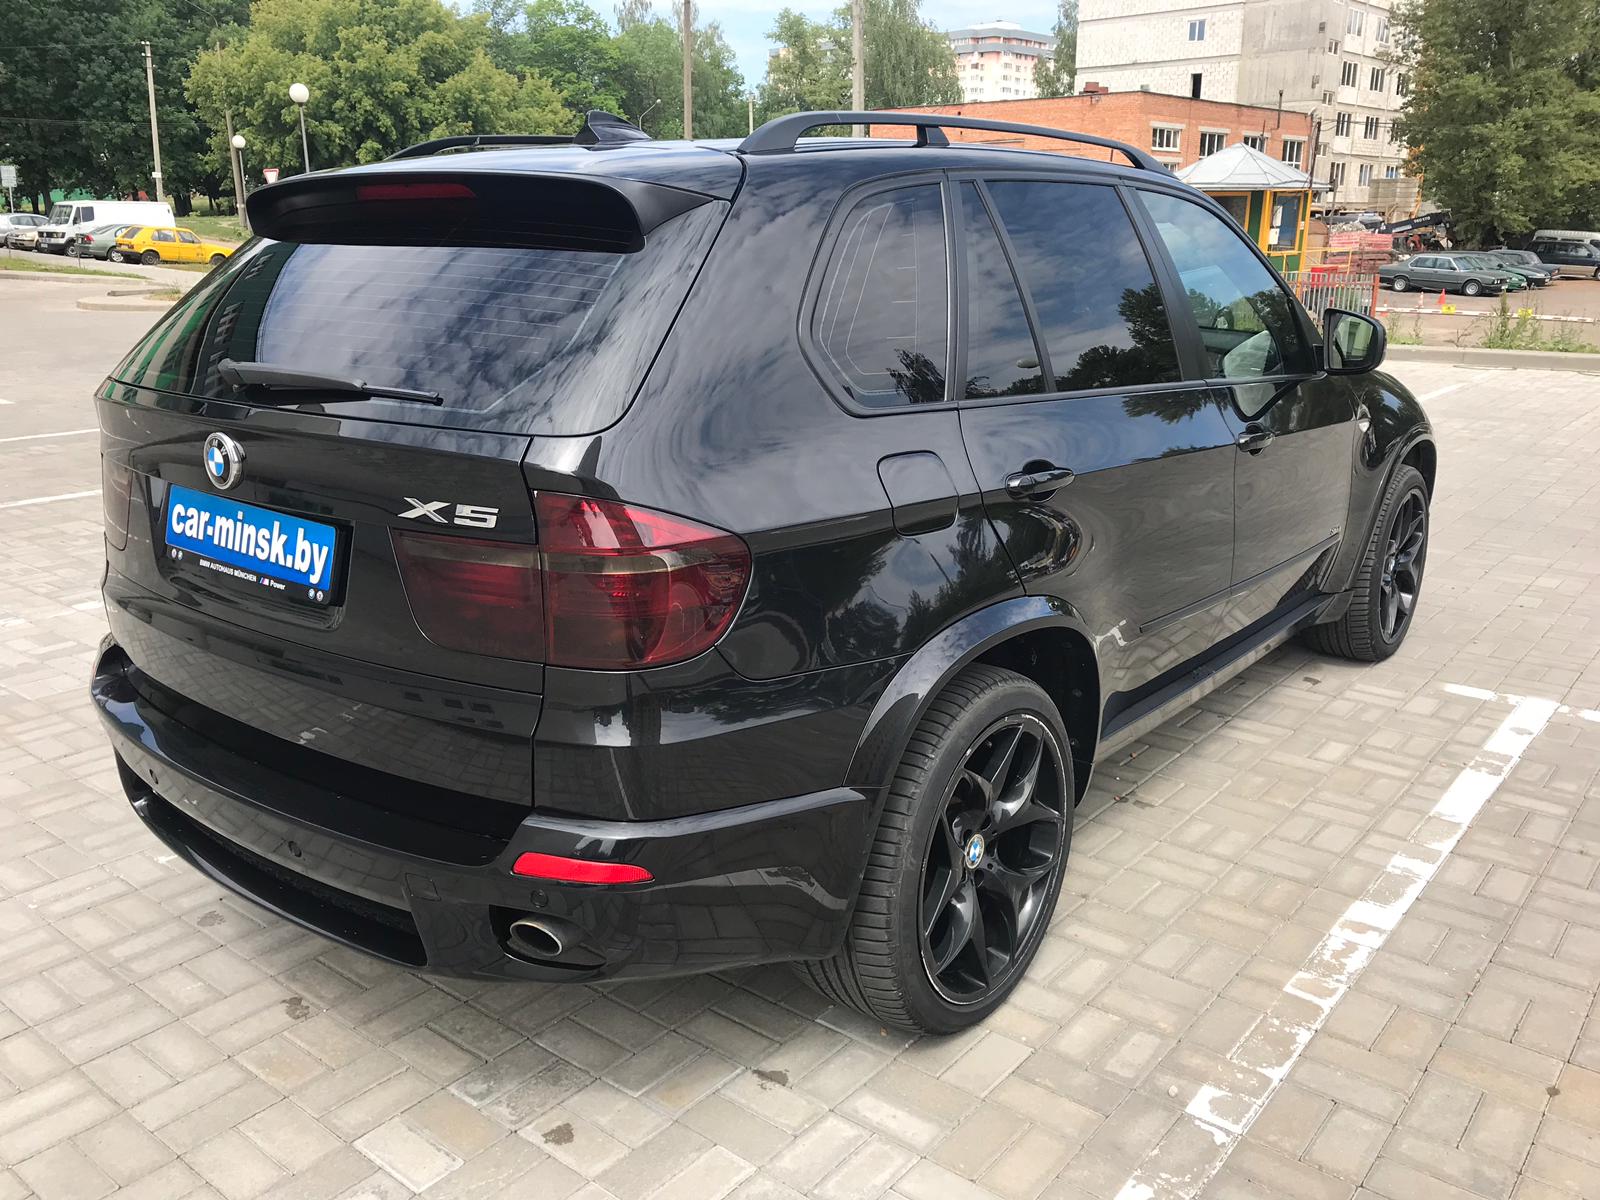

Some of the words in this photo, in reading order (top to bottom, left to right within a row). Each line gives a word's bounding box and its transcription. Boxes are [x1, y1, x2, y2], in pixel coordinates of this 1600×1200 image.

[397, 497, 499, 529] X5
[210, 562, 234, 576] AUTOHAUS
[269, 579, 286, 590] Power
